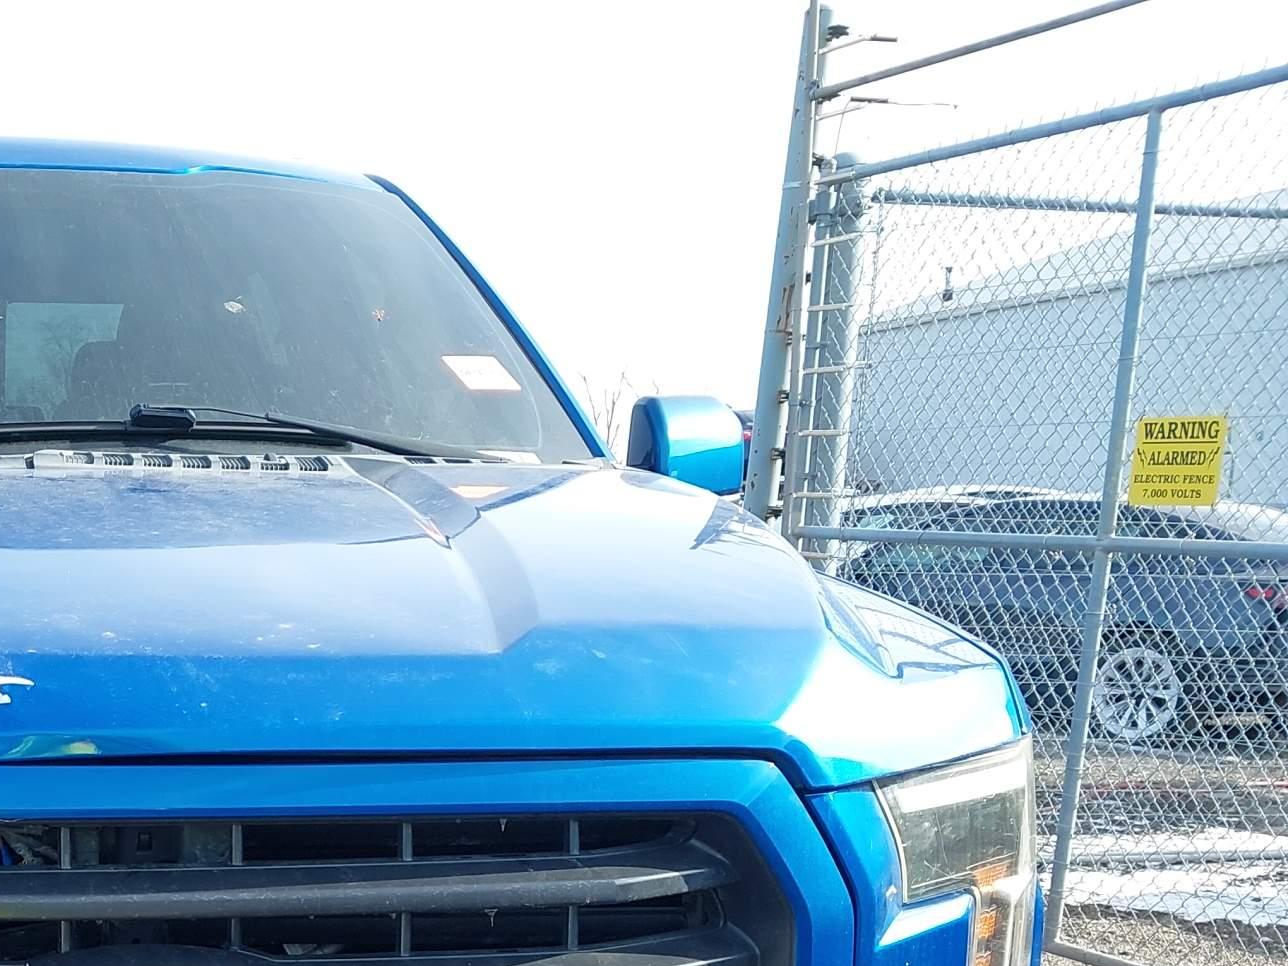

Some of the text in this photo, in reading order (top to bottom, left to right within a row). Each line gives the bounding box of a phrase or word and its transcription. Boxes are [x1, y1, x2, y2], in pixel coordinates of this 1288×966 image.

[1144, 421, 1220, 440] WARNING
[1148, 451, 1207, 466] ALARMED
[1134, 474, 1215, 485] ELECTRIC FENCE
[1171, 489, 1202, 499] VOLTS
